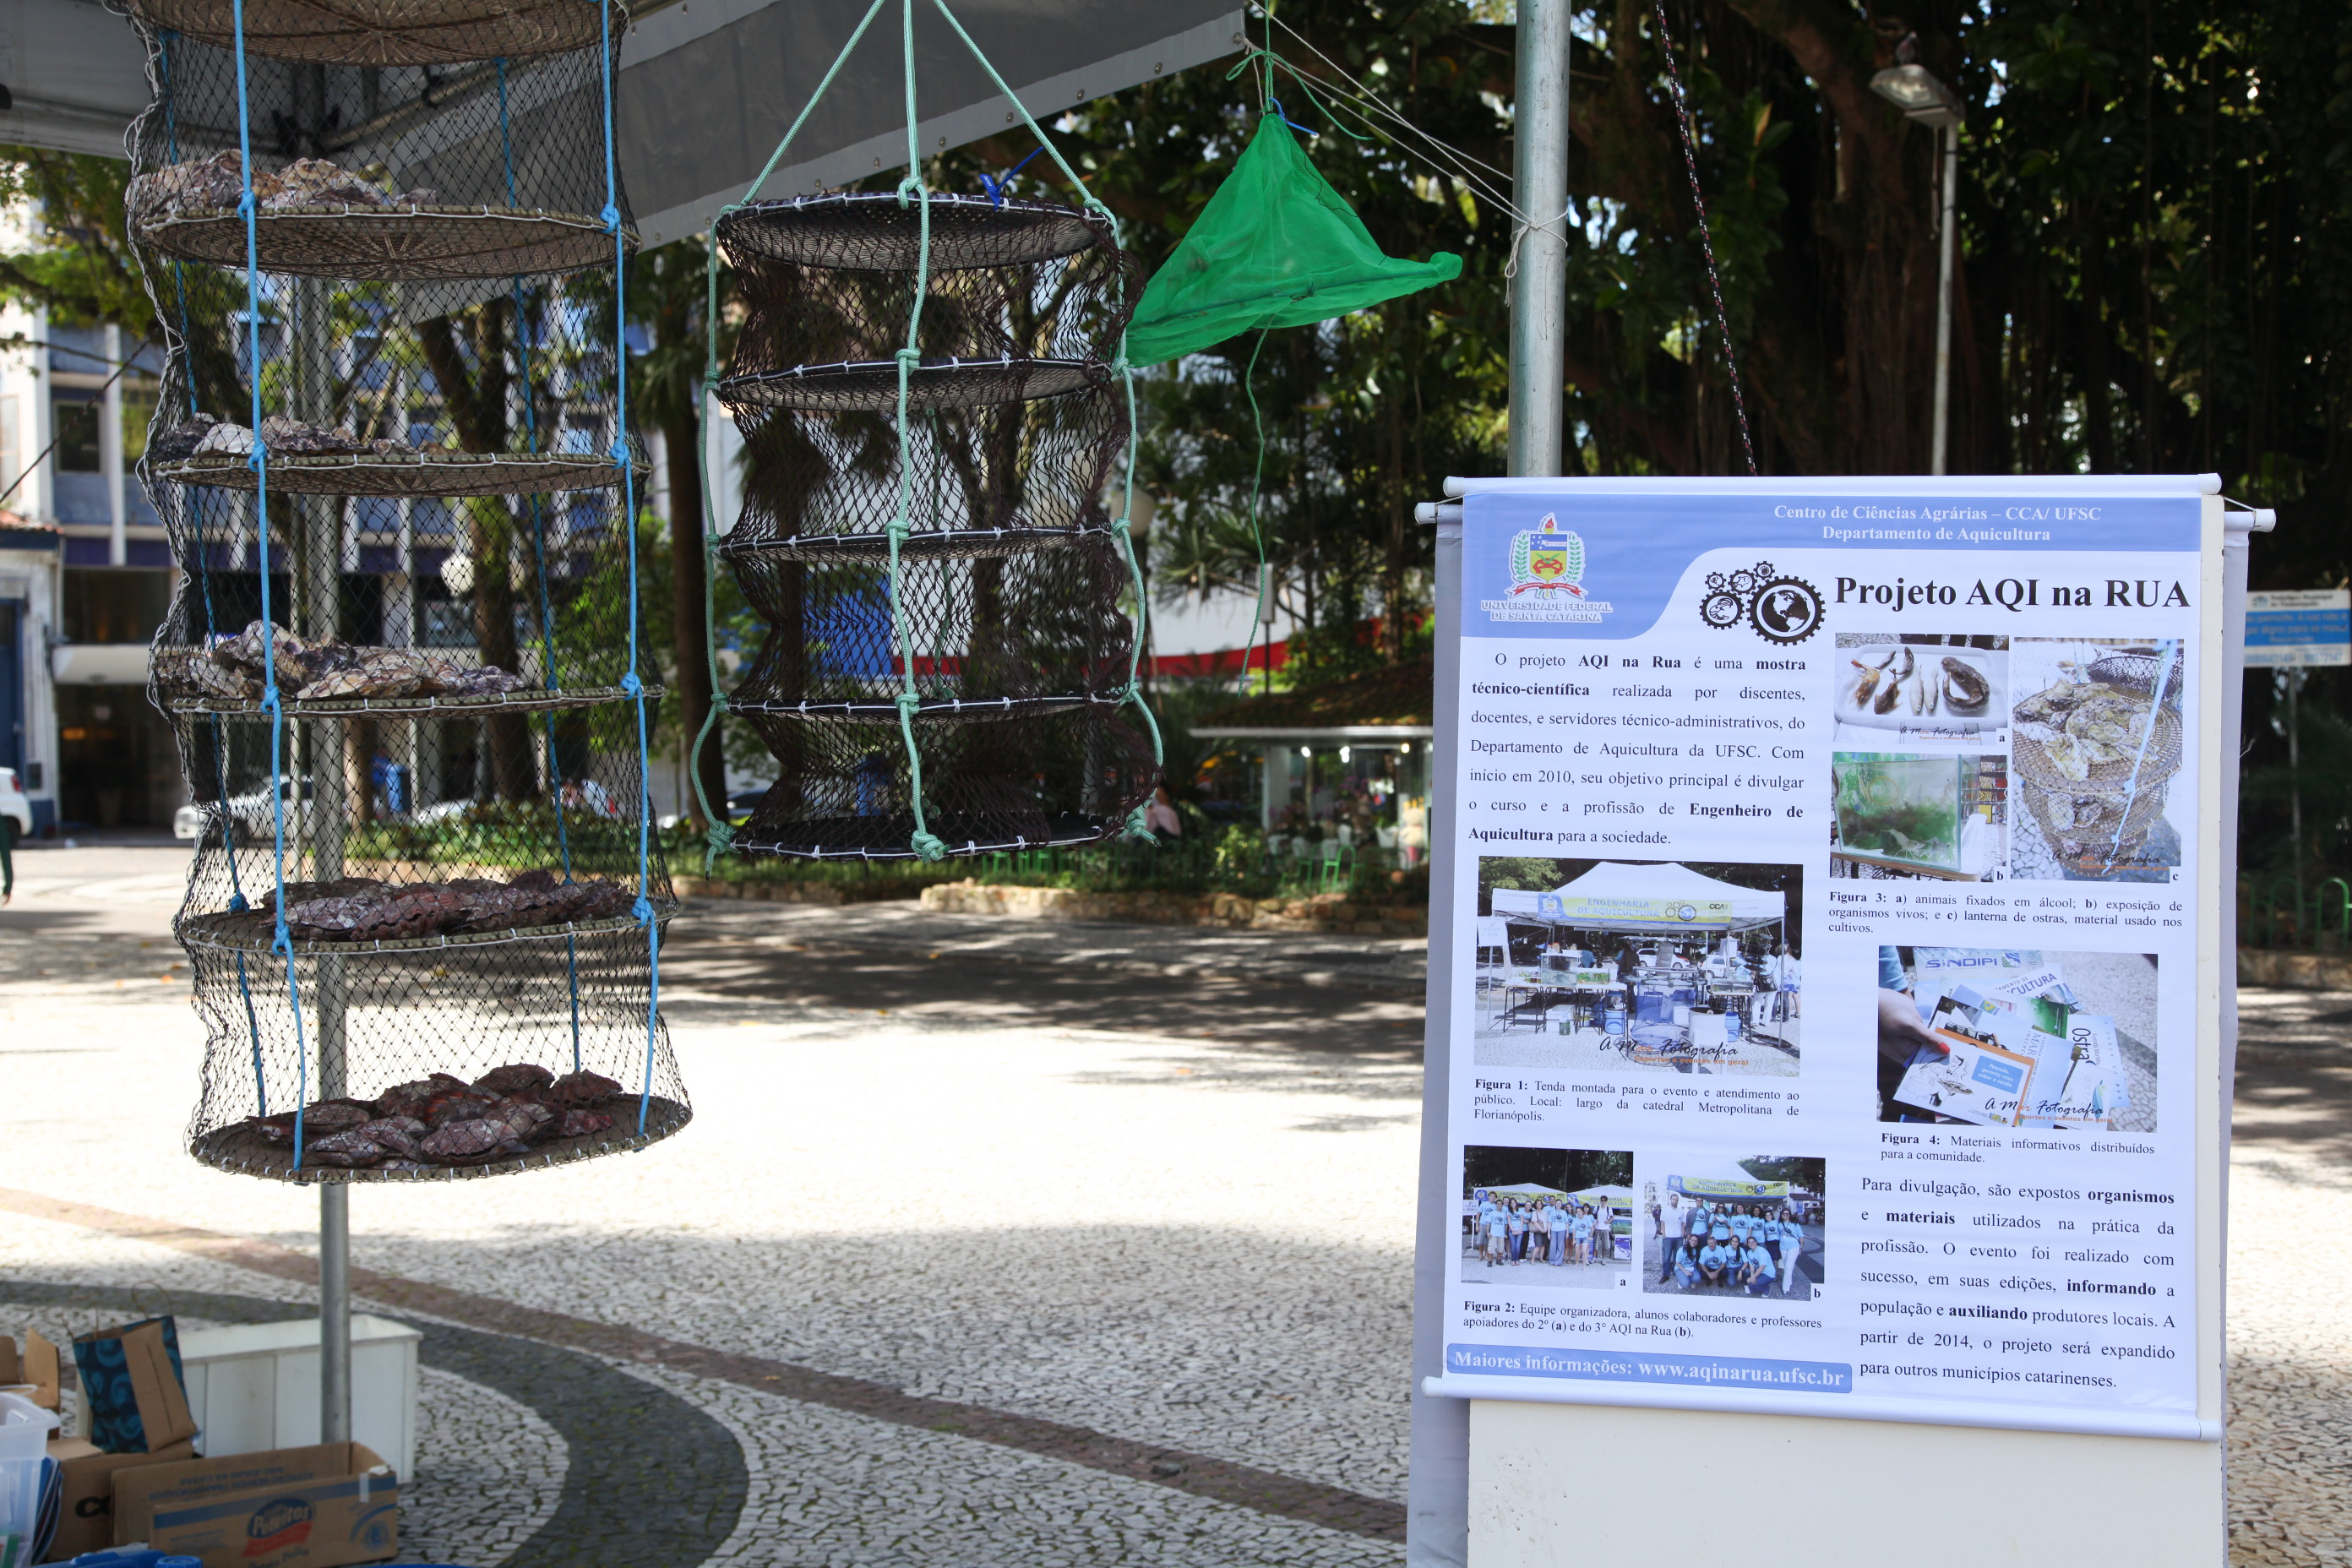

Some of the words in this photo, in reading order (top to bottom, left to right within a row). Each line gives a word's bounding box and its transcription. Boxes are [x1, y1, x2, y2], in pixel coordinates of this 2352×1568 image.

[1774, 504, 1826, 518] Centro
[1830, 505, 1848, 518] de
[1852, 505, 1916, 519] Ciências
[1920, 506, 1987, 523] Agrárias
[2005, 506, 2050, 520] CCA/
[2054, 507, 2101, 520] UFSC
[1822, 525, 1931, 542] Departamento
[1935, 527, 1953, 540] de
[1956, 527, 2050, 544] Aquicultura
[1834, 577, 1956, 612] Projeto
[1964, 578, 2040, 612] AQI
[2051, 586, 2092, 606] na
[2103, 579, 2191, 607] RUA
[1482, 601, 1563, 611] UNIVERSIDADE
[1565, 602, 1612, 611] FEDERAL
[1492, 612, 1506, 621] DE
[1509, 612, 1543, 621] SANTA
[1546, 612, 1602, 621] CATARINA
[1494, 652, 1506, 665] O
[1519, 653, 1565, 669] projeto
[1578, 654, 1608, 669] AQI
[1622, 658, 1639, 667] na
[1652, 655, 1681, 668] Rua
[1694, 656, 1701, 669] é
[1714, 660, 1743, 669] uma
[1756, 659, 1806, 670] mostra
[1999, 734, 2006, 743] a
[1468, 827, 1553, 843] Aquicultura
[1557, 832, 1586, 844] para
[1590, 833, 1597, 842] a
[1602, 830, 1670, 844] sociedade.
[1996, 870, 2004, 881] b
[1588, 898, 1649, 908] ENGENHARIA
[1829, 891, 1867, 904] Figura
[1875, 892, 1886, 902] 3:
[1895, 894, 1907, 905] a)
[1915, 894, 1957, 904] animais
[1966, 894, 2005, 906] fixados
[2039, 896, 2076, 909] álcool;
[2085, 898, 2097, 910] b)
[2105, 900, 2160, 912] exposição
[2169, 900, 2182, 911] de
[1594, 908, 1659, 917] AQUICULTURA
[1828, 907, 1889, 919] organismos
[1895, 908, 1928, 920] vivos;
[1946, 911, 1957, 921] c)
[1964, 910, 2007, 921] lanterna
[2013, 911, 2026, 922] de
[2032, 914, 2067, 924] ostras,
[2074, 914, 2118, 925] material
[2124, 915, 2156, 926] usado
[1828, 922, 1873, 933] cultivos.
[1660, 1039, 1738, 1060] Fotografia
[1475, 1078, 1511, 1091] Figura
[1518, 1080, 1527, 1090] 1:
[1534, 1080, 1565, 1091] Tenda
[1571, 1083, 1615, 1093] montada
[1621, 1086, 1644, 1096] para
[1662, 1087, 1698, 1096] evento
[1715, 1088, 1780, 1099] atendimento
[1474, 1093, 1515, 1106] público.
[1530, 1095, 1561, 1106] Local:
[1576, 1097, 1602, 1110] largo
[1616, 1098, 1629, 1109] da
[1642, 1100, 1683, 1111] catedral
[1698, 1102, 1772, 1116] Metropolitana
[1786, 1105, 1799, 1116] de
[1985, 1098, 1995, 1111] A
[2036, 1100, 2104, 1119] Fotografia
[1474, 1108, 1545, 1123] Florianópolis.
[1881, 1132, 1919, 1146] Figura
[1929, 1134, 1940, 1145] 4:
[1950, 1135, 2001, 1147] Materiais
[2011, 1138, 2080, 1151] informativos
[2090, 1141, 2154, 1154] distribuídos
[1880, 1150, 1904, 1161] para
[1915, 1150, 1985, 1162] comunidade.
[1862, 1177, 1892, 1191] Para
[1899, 1179, 1980, 1197] divulgação,
[1988, 1183, 2011, 1196] são
[2018, 1188, 2080, 1201] expostos
[2087, 1189, 2174, 1204] organismos
[1620, 1278, 1626, 1287] a
[1813, 1288, 1821, 1298] b
[1464, 1300, 1500, 1313] Figura
[1504, 1302, 1515, 1313] 2:
[1520, 1303, 1556, 1317] Equipe
[1560, 1306, 1630, 1319] organizadora,
[1634, 1308, 1669, 1320] alunos
[1673, 1310, 1746, 1324] colaboradores
[1761, 1315, 1822, 1328] professores
[1463, 1316, 1519, 1329] apoiadores
[1521, 1318, 1535, 1329] do
[1551, 1320, 1566, 1332] (a)
[1578, 1321, 1591, 1332] do
[1608, 1323, 1631, 1336] AQI
[1635, 1326, 1647, 1334] na
[1651, 1324, 1671, 1336] Rua
[1674, 1326, 1693, 1338] (b).
[1860, 1330, 1898, 1346] partir
[1907, 1331, 1924, 1345] de
[1933, 1333, 1973, 1349] 2014,
[1983, 1339, 1992, 1349] o
[2001, 1337, 2052, 1354] projeto
[2062, 1341, 2091, 1354] será
[2101, 1344, 2175, 1360] expandido
[1454, 1351, 1521, 1369] Maiores
[1525, 1354, 1632, 1376] informações:
[1637, 1362, 1844, 1385] www.aqinarua.ufsc.br
[1860, 1363, 1890, 1376] para
[1894, 1364, 1938, 1377] outros
[1942, 1365, 2020, 1383] municípios
[2025, 1370, 2116, 1387] catarinenses.
